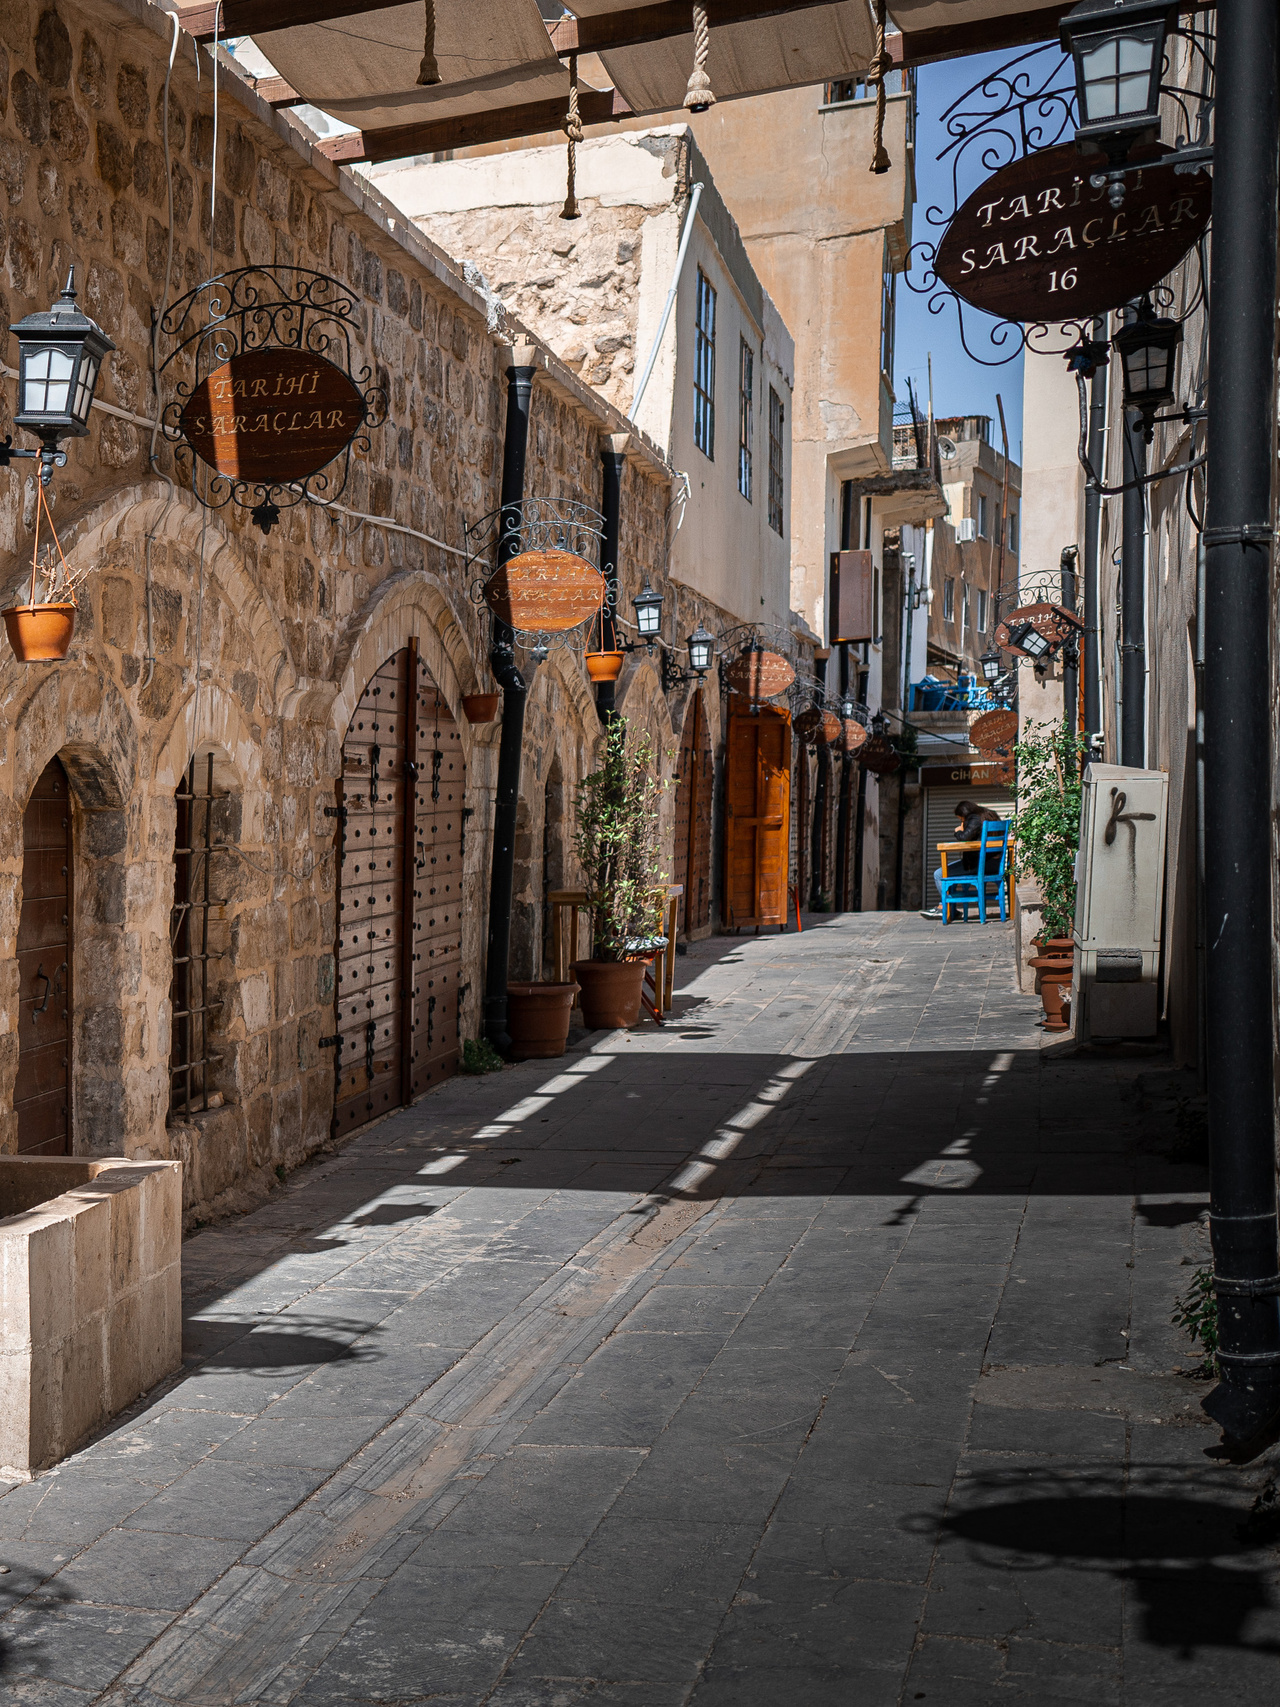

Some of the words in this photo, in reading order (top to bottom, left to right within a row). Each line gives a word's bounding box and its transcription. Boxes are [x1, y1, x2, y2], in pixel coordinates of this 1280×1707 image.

[960, 198, 1199, 275] SARAÇLAR
[1048, 267, 1078, 293] 16
[214, 371, 321, 399] TARİHİ
[195, 410, 346, 436] SARAÇLAR
[950, 768, 990, 781] CİHAN
